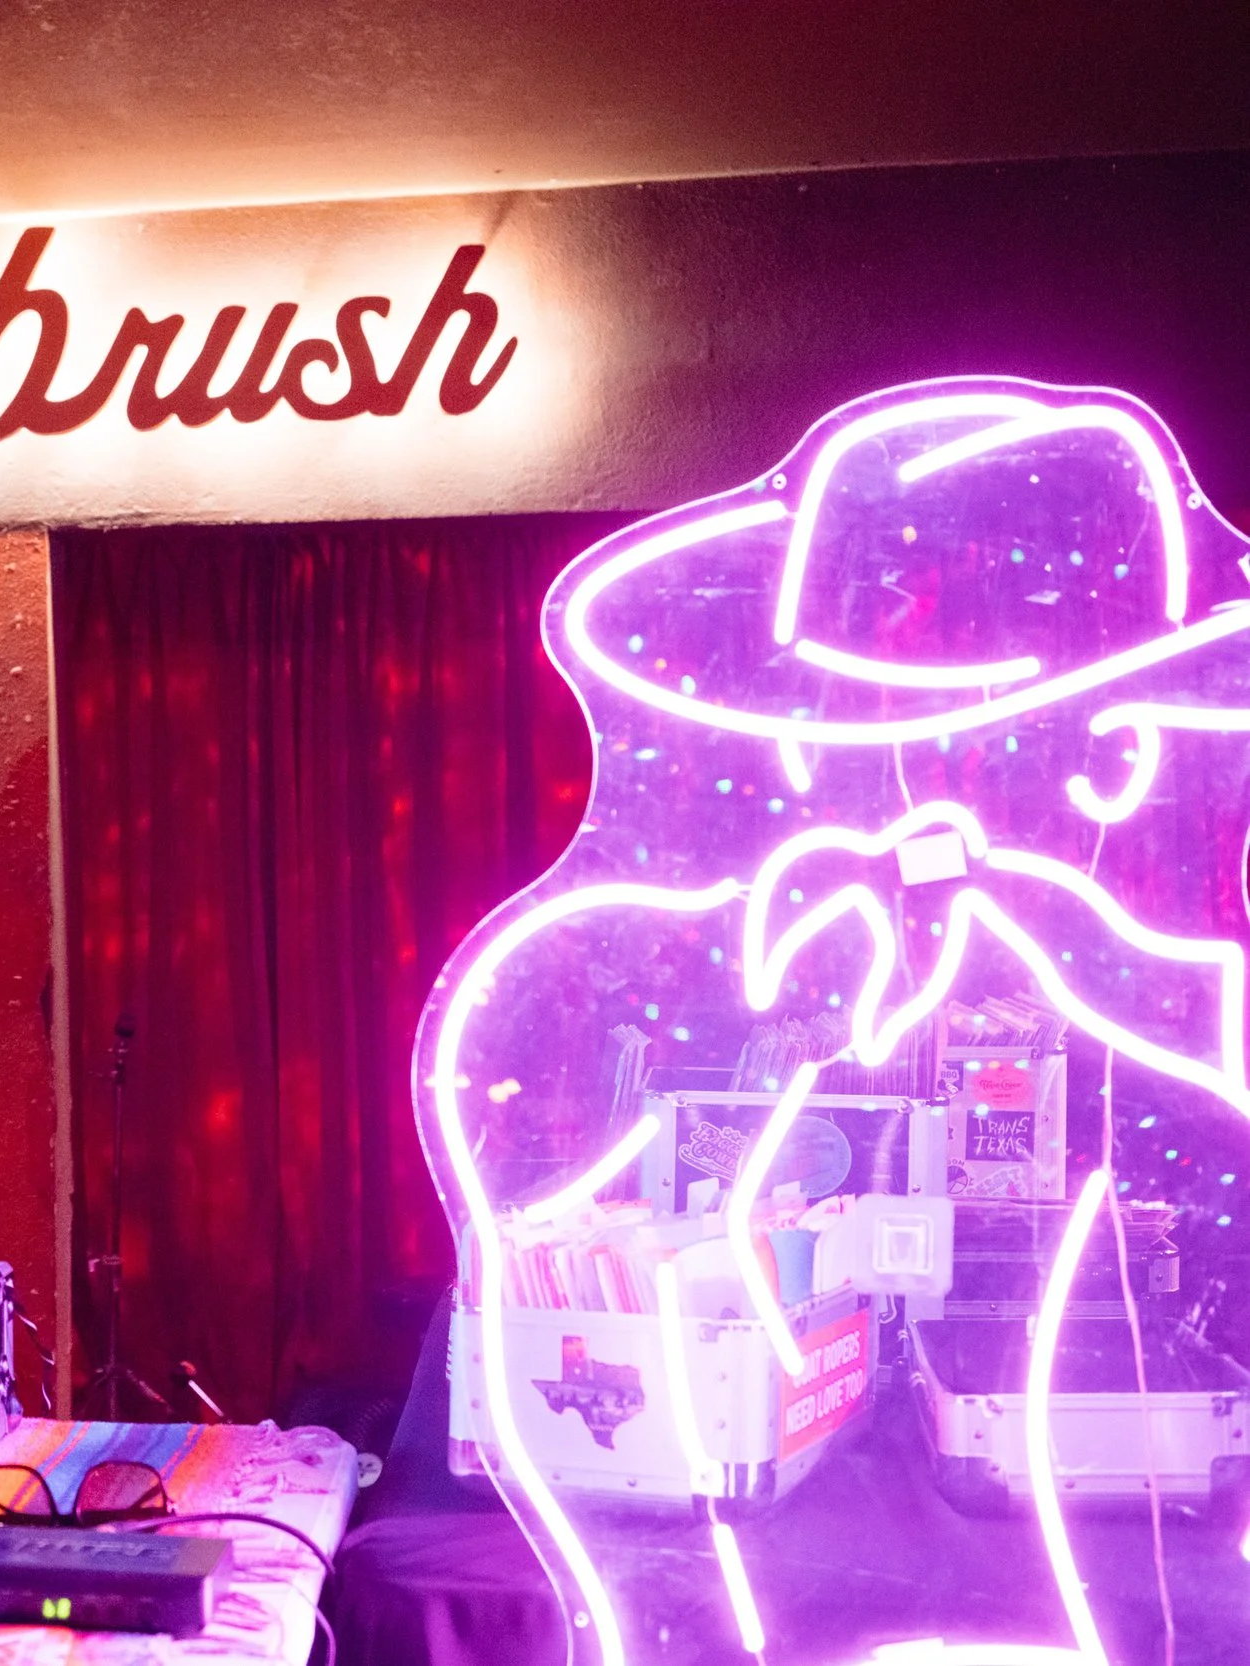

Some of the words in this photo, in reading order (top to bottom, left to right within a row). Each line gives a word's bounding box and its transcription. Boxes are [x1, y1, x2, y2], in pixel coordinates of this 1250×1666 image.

[973, 1115, 1031, 1136] TRANS
[973, 1135, 1028, 1156] TEXAS
[822, 1329, 861, 1375] ROPERS
[785, 1392, 817, 1437] NEED
[816, 1376, 845, 1420] LOVE
[843, 1367, 863, 1403] TOO
